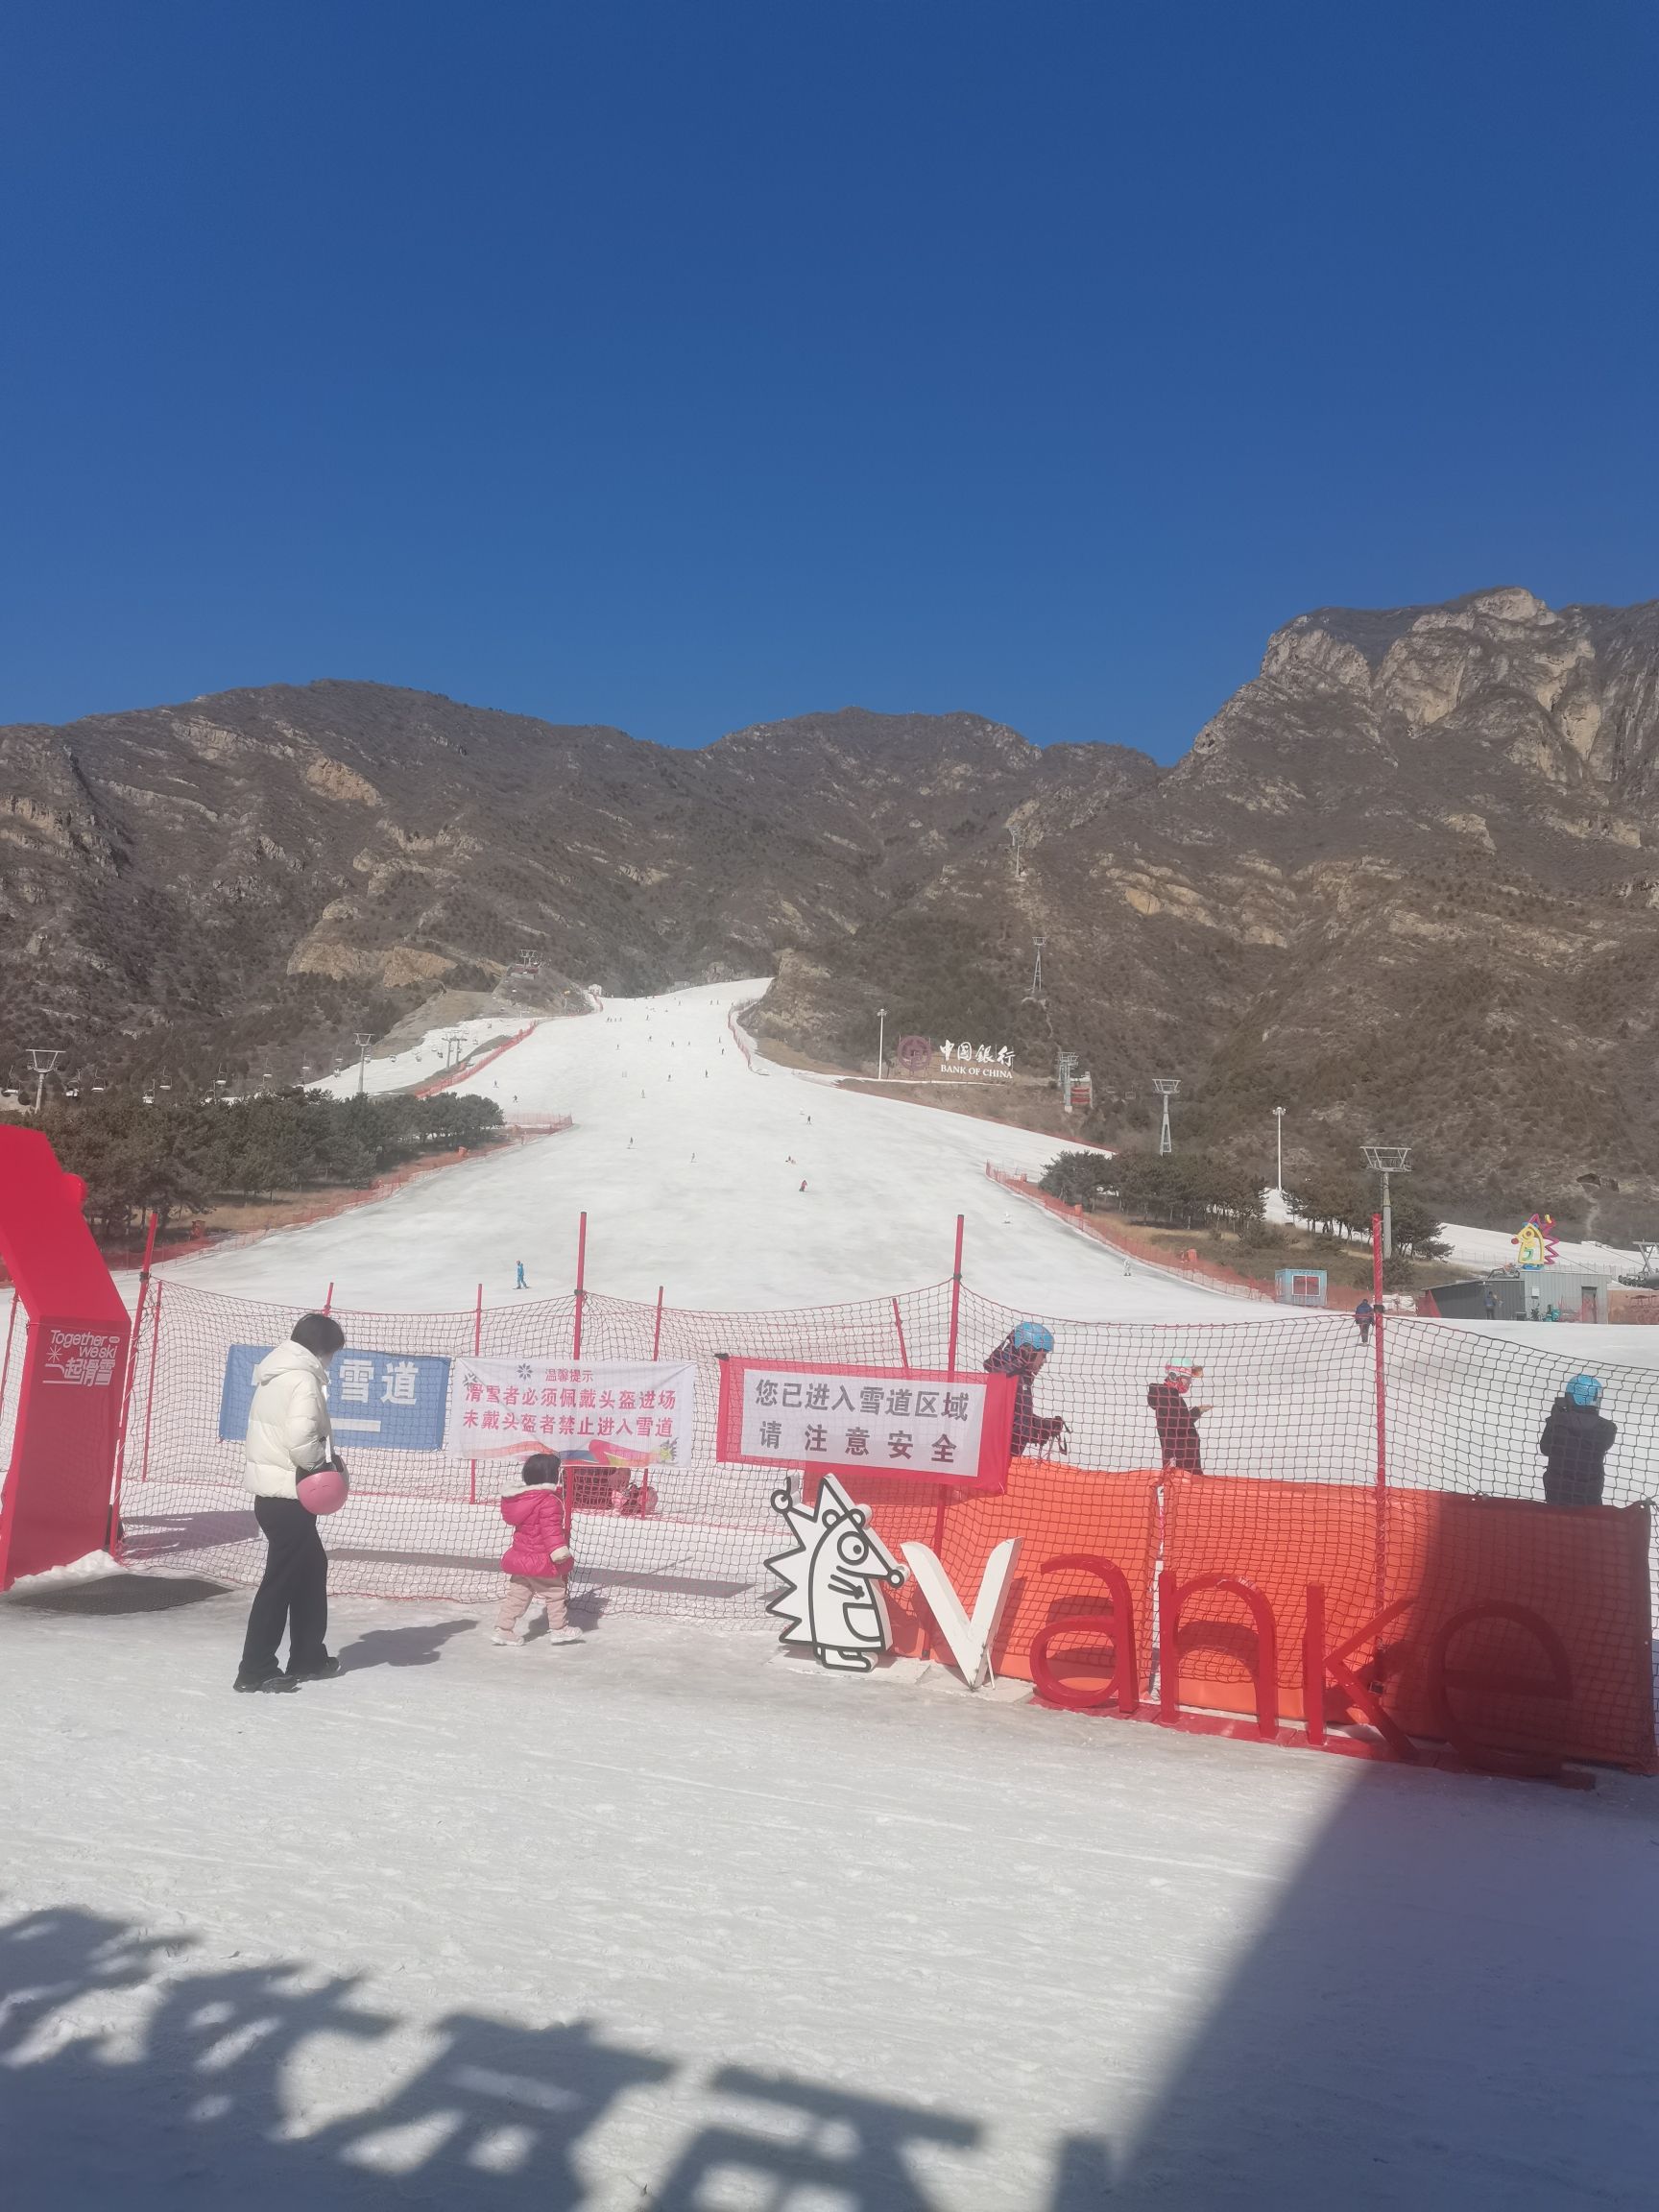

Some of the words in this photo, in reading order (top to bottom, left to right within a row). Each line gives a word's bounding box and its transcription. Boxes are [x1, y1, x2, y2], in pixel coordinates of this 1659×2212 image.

[941, 1064, 966, 1074] BANK
[969, 1067, 981, 1076] OF
[982, 1069, 1013, 1079] CHINA
[51, 1330, 108, 1347] Together
[544, 1368, 593, 1383] 温馨提示
[465, 1383, 676, 1410] 滑雪者必须佩戴头盔进场
[756, 1379, 970, 1422] 您已进入雪道区域
[463, 1409, 674, 1437] 未戴头盔者禁止进入雪道
